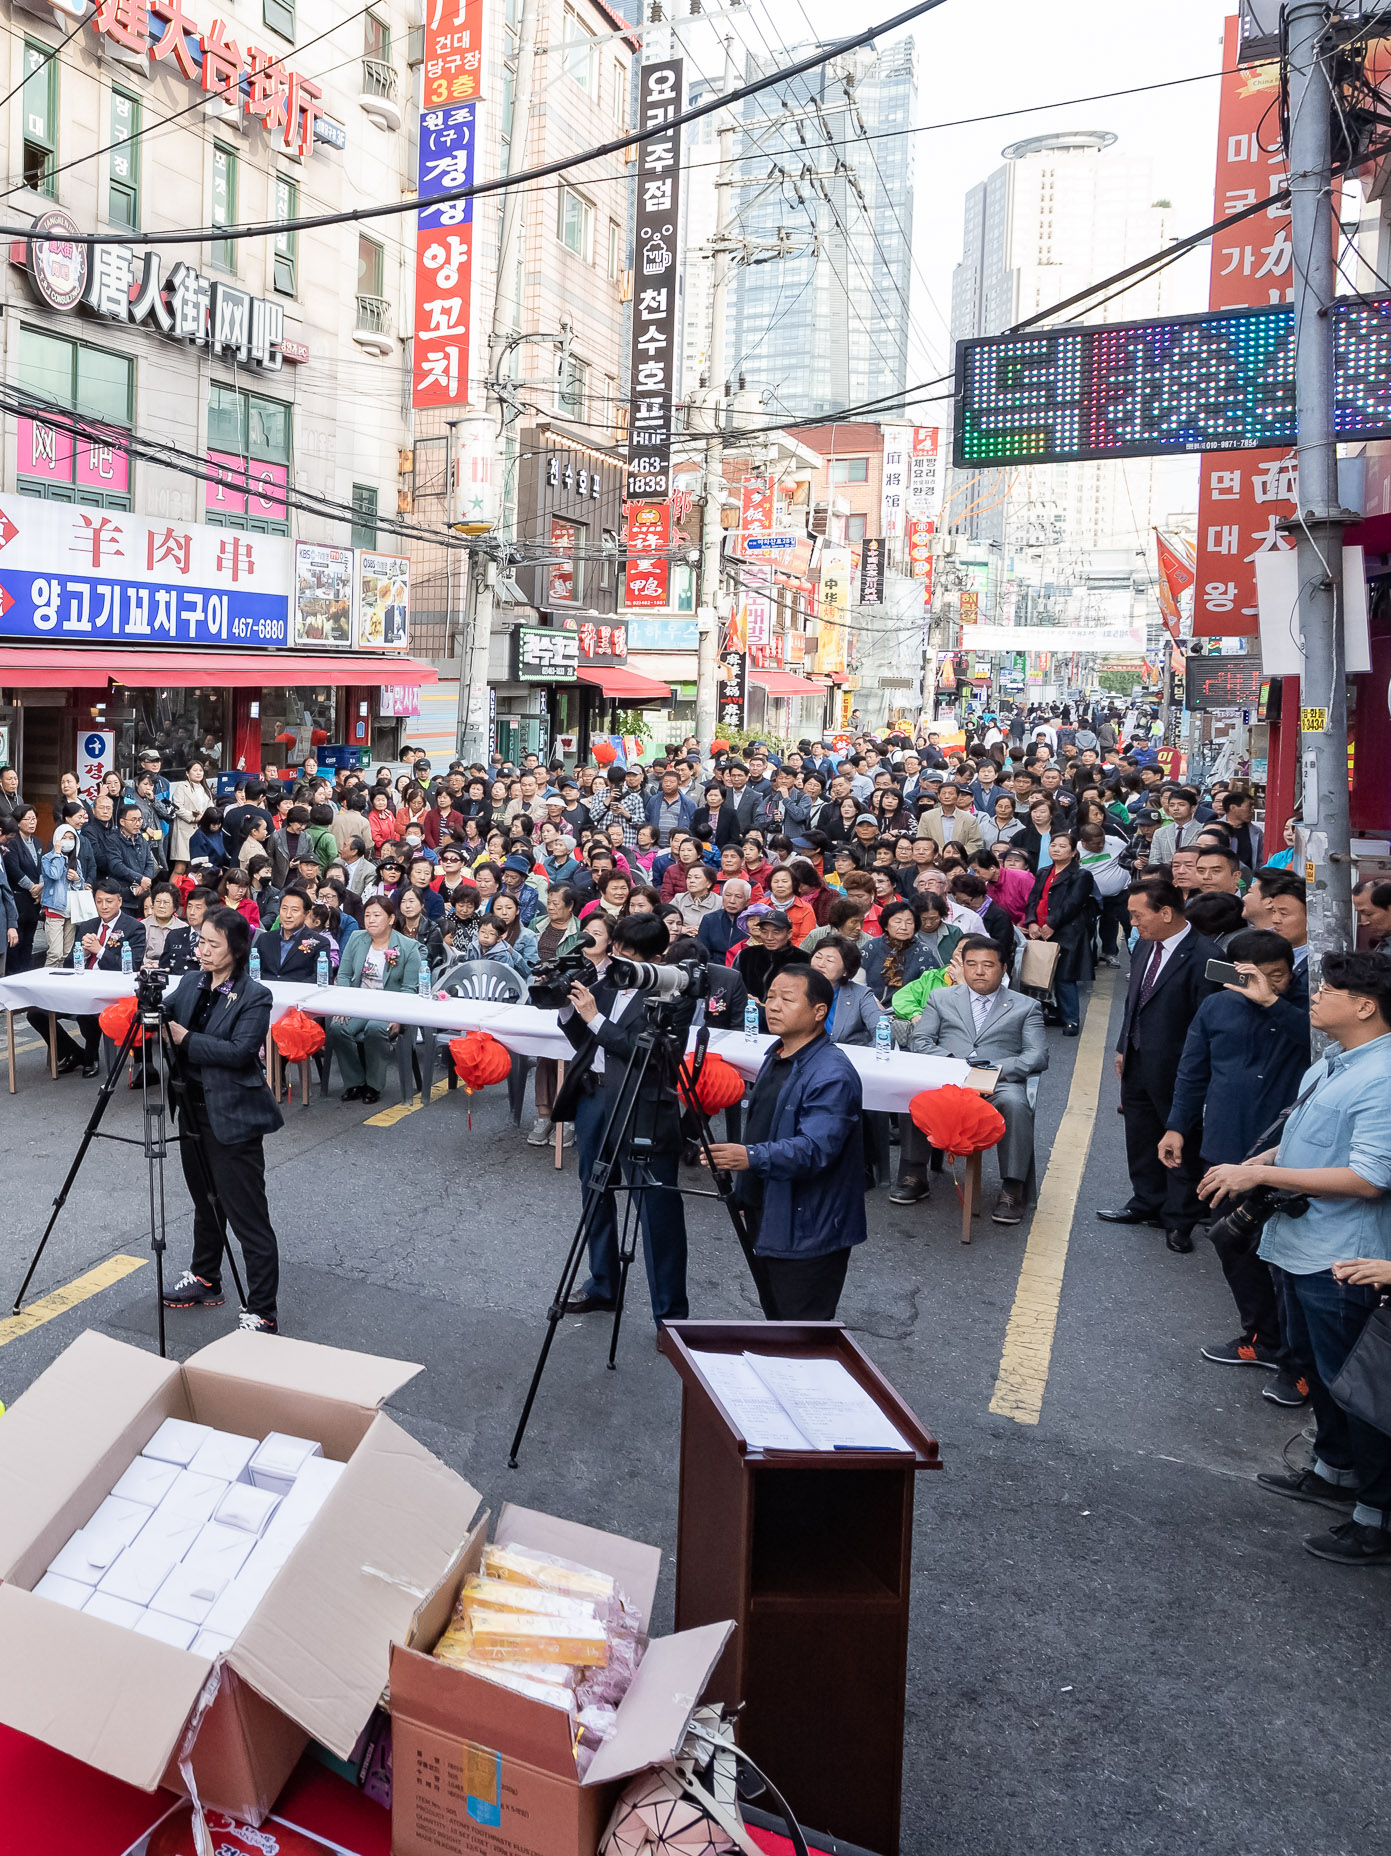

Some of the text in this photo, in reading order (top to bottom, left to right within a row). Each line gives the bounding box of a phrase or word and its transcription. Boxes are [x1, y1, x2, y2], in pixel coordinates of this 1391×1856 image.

[435, 32, 470, 54] 건대
[427, 50, 481, 79] 당구장
[431, 74, 476, 103] 3층
[422, 106, 474, 131] 원조
[429, 126, 469, 149] (구)
[88, 243, 285, 373] 唐人街网吧
[417, 235, 469, 398] 양꼬치
[549, 458, 600, 499] 천수호프
[629, 456, 669, 474] 463-
[628, 475, 667, 493] 1833
[68, 512, 256, 583] 羊肉串
[30, 577, 285, 640] 양고기꼬치구이 467-6880
